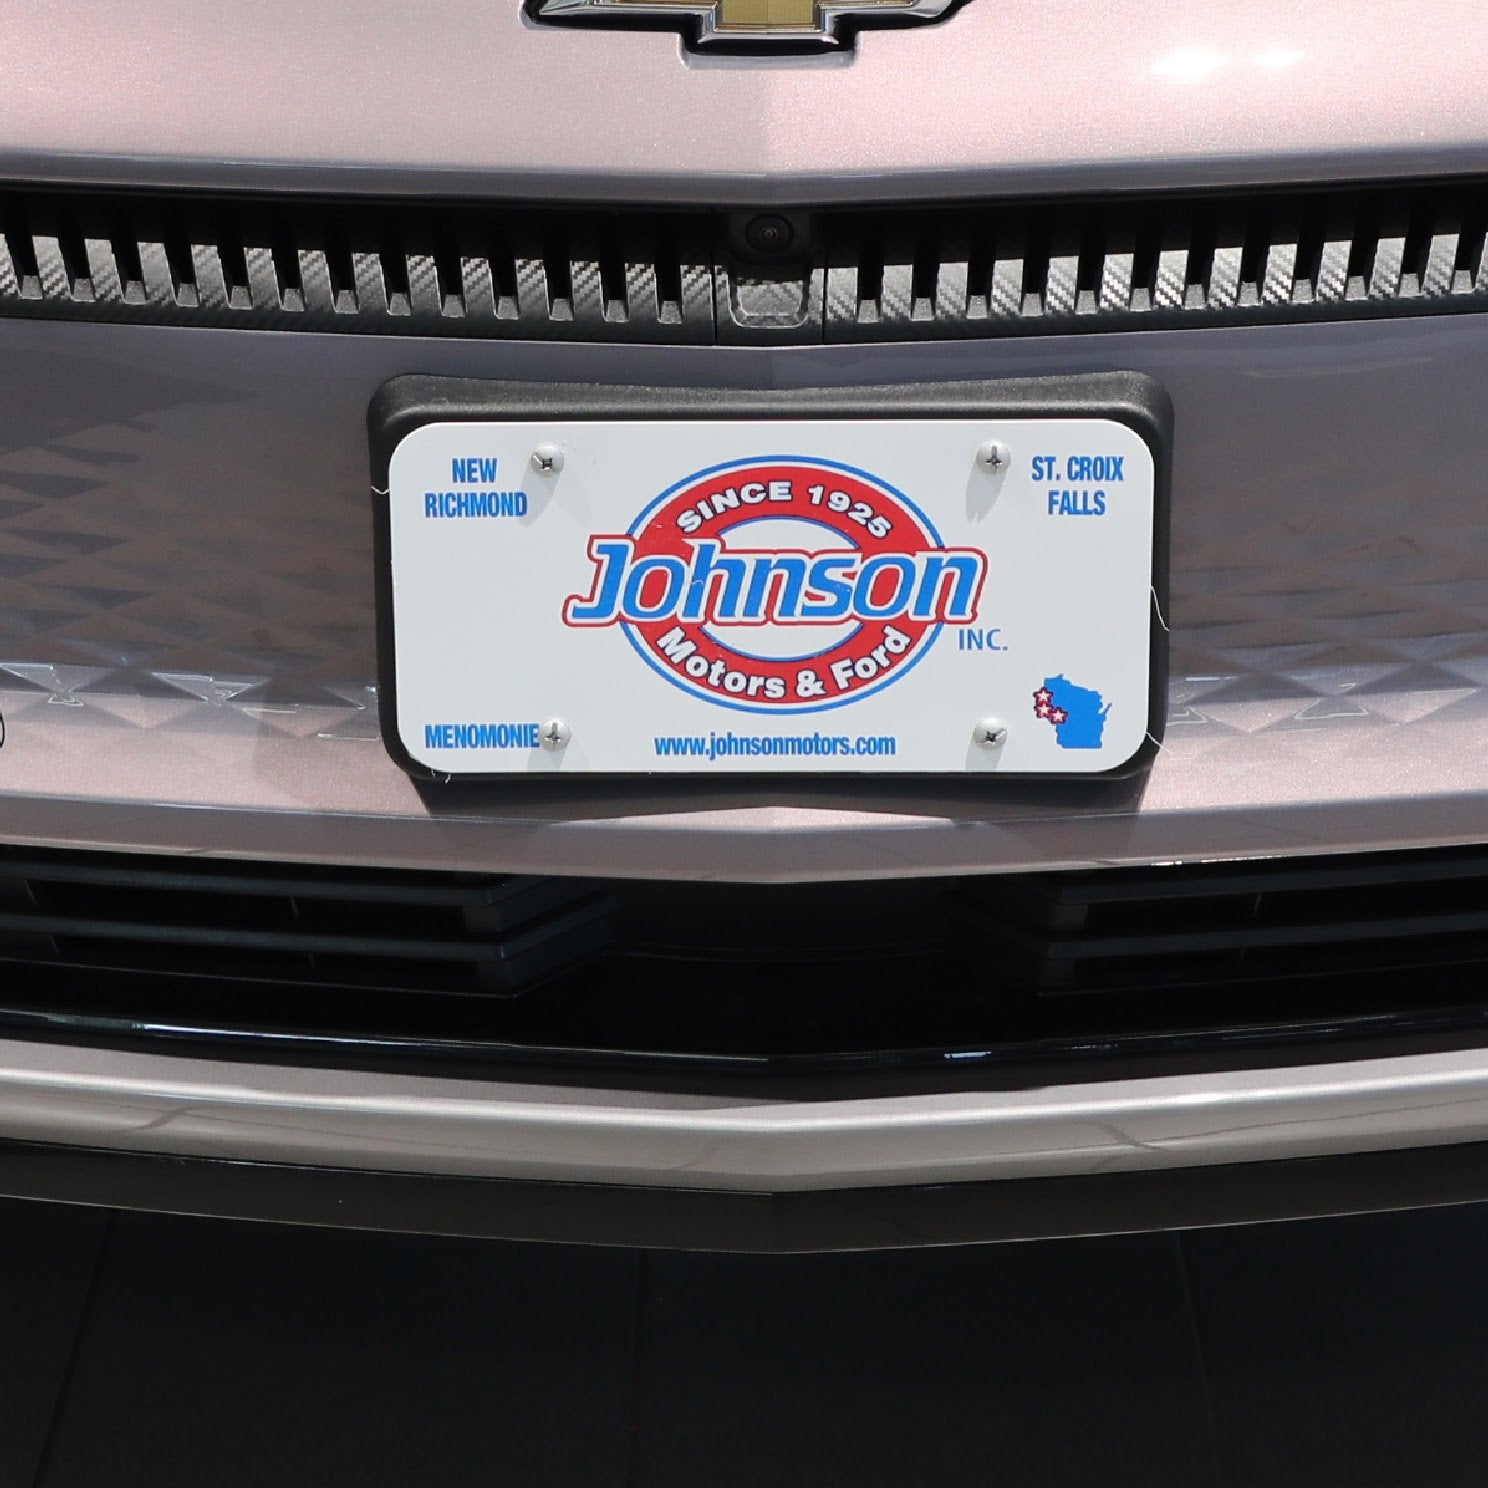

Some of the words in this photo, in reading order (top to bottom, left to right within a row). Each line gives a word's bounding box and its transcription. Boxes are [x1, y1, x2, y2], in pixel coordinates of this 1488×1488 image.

[451, 457, 498, 484] NEW
[1031, 455, 1061, 481] ST.
[1067, 455, 1125, 481] CROIX
[424, 491, 529, 518] RICHMOND
[676, 479, 793, 534] SINCE
[808, 484, 894, 539] 1925
[1047, 489, 1107, 516] FALLS
[562, 534, 989, 627] Johnson
[958, 628, 1009, 651] INC.
[655, 624, 788, 700] Motors
[795, 670, 828, 699] &
[830, 625, 913, 690] Ford
[424, 722, 541, 749] MENOMONIE
[654, 731, 897, 761] www.johnsonmotors.com
